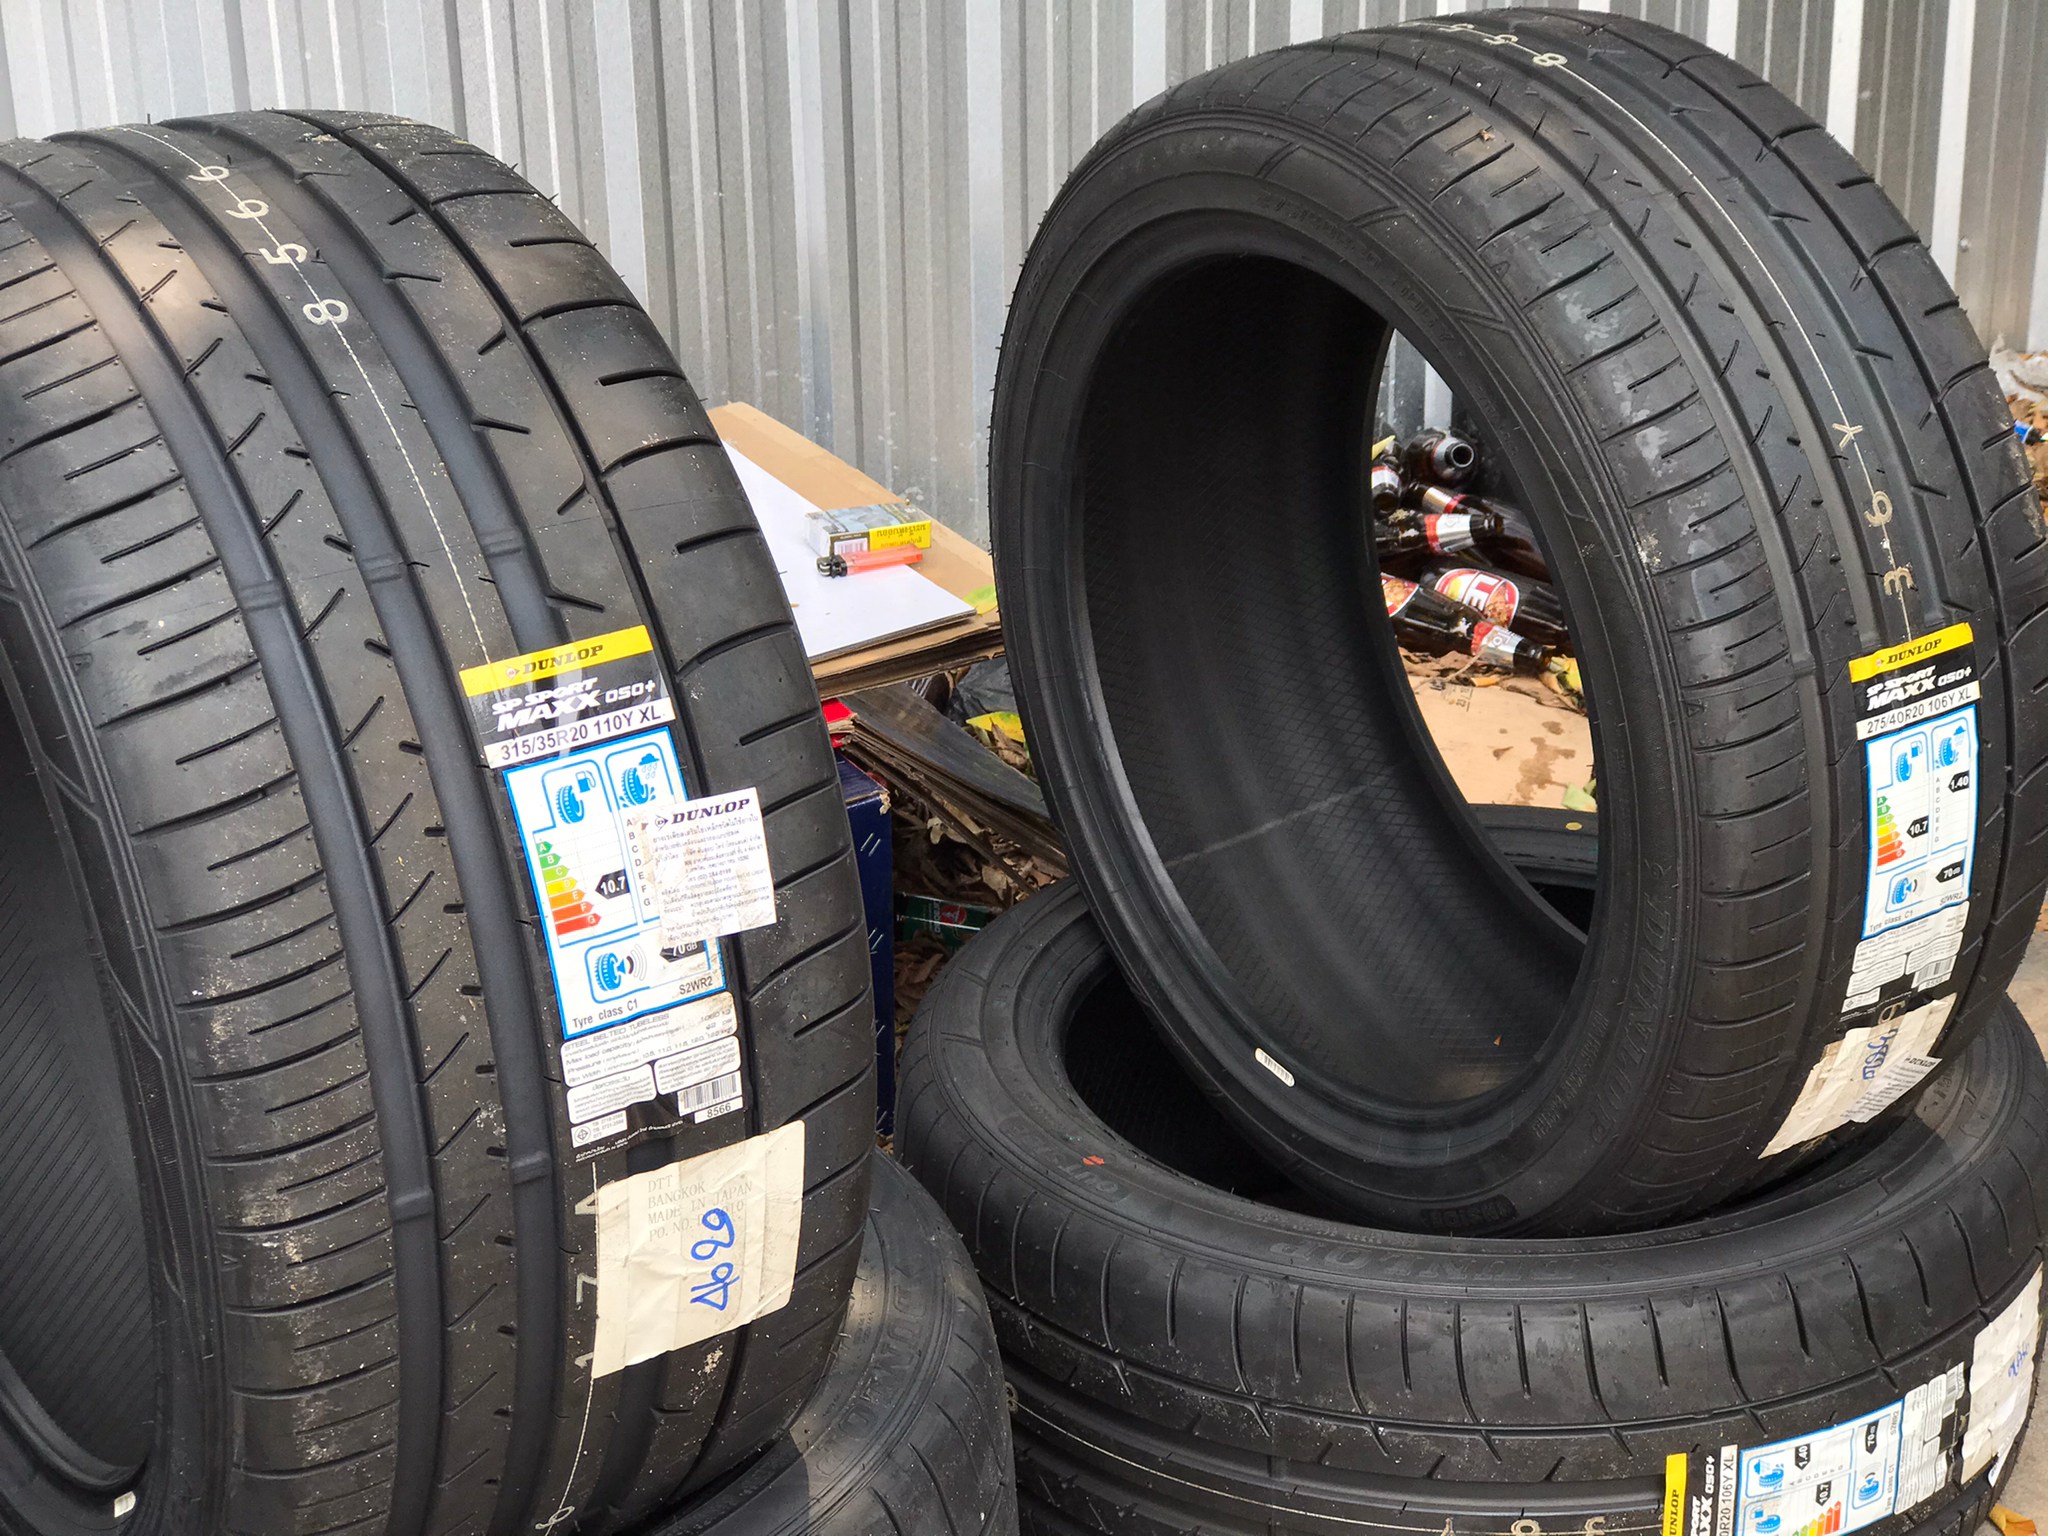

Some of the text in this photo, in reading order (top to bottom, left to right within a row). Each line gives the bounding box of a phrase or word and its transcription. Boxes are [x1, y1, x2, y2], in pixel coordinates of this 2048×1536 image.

[523, 644, 604, 675] DUNLOP
[1887, 639, 1941, 664] DUNLOP
[1884, 665, 1937, 687] SPORT
[492, 677, 598, 716] SP SPORT
[1867, 675, 1937, 711] MAXX
[496, 679, 656, 732] MAXX 050+
[1867, 689, 1972, 734] 275/40R20 106Y XL
[500, 704, 661, 762] 315/35R20 110Y XL
[1950, 776, 1969, 790] 1.40
[671, 798, 750, 824] DUNLOP
[626, 819, 633, 827] A
[1910, 820, 1928, 835] 10.7
[629, 832, 635, 840] B
[632, 845, 639, 853] C
[635, 858, 642, 867] D
[638, 871, 645, 880] E
[1943, 868, 1953, 878] 70
[600, 874, 626, 897] 10.7
[641, 885, 647, 893] F
[643, 898, 651, 906] G
[1885, 914, 1902, 924] class
[679, 976, 713, 995] S2WR2
[572, 998, 639, 1029] Tyre class C1
[707, 1103, 731, 1118] 8566
[648, 1175, 672, 1192] DTT
[648, 1181, 705, 1208] BANGKOK
[648, 1181, 752, 1224] MADE IN JAPAN
[650, 1227, 668, 1241] PO.
[673, 1218, 692, 1234] NO.
[1868, 1434, 1875, 1446] 70
[1723, 1455, 1734, 1471] XL
[1798, 1445, 1808, 1466] 1.40
[1722, 1475, 1733, 1503] 106Y
[1820, 1483, 1829, 1502] 10.7
